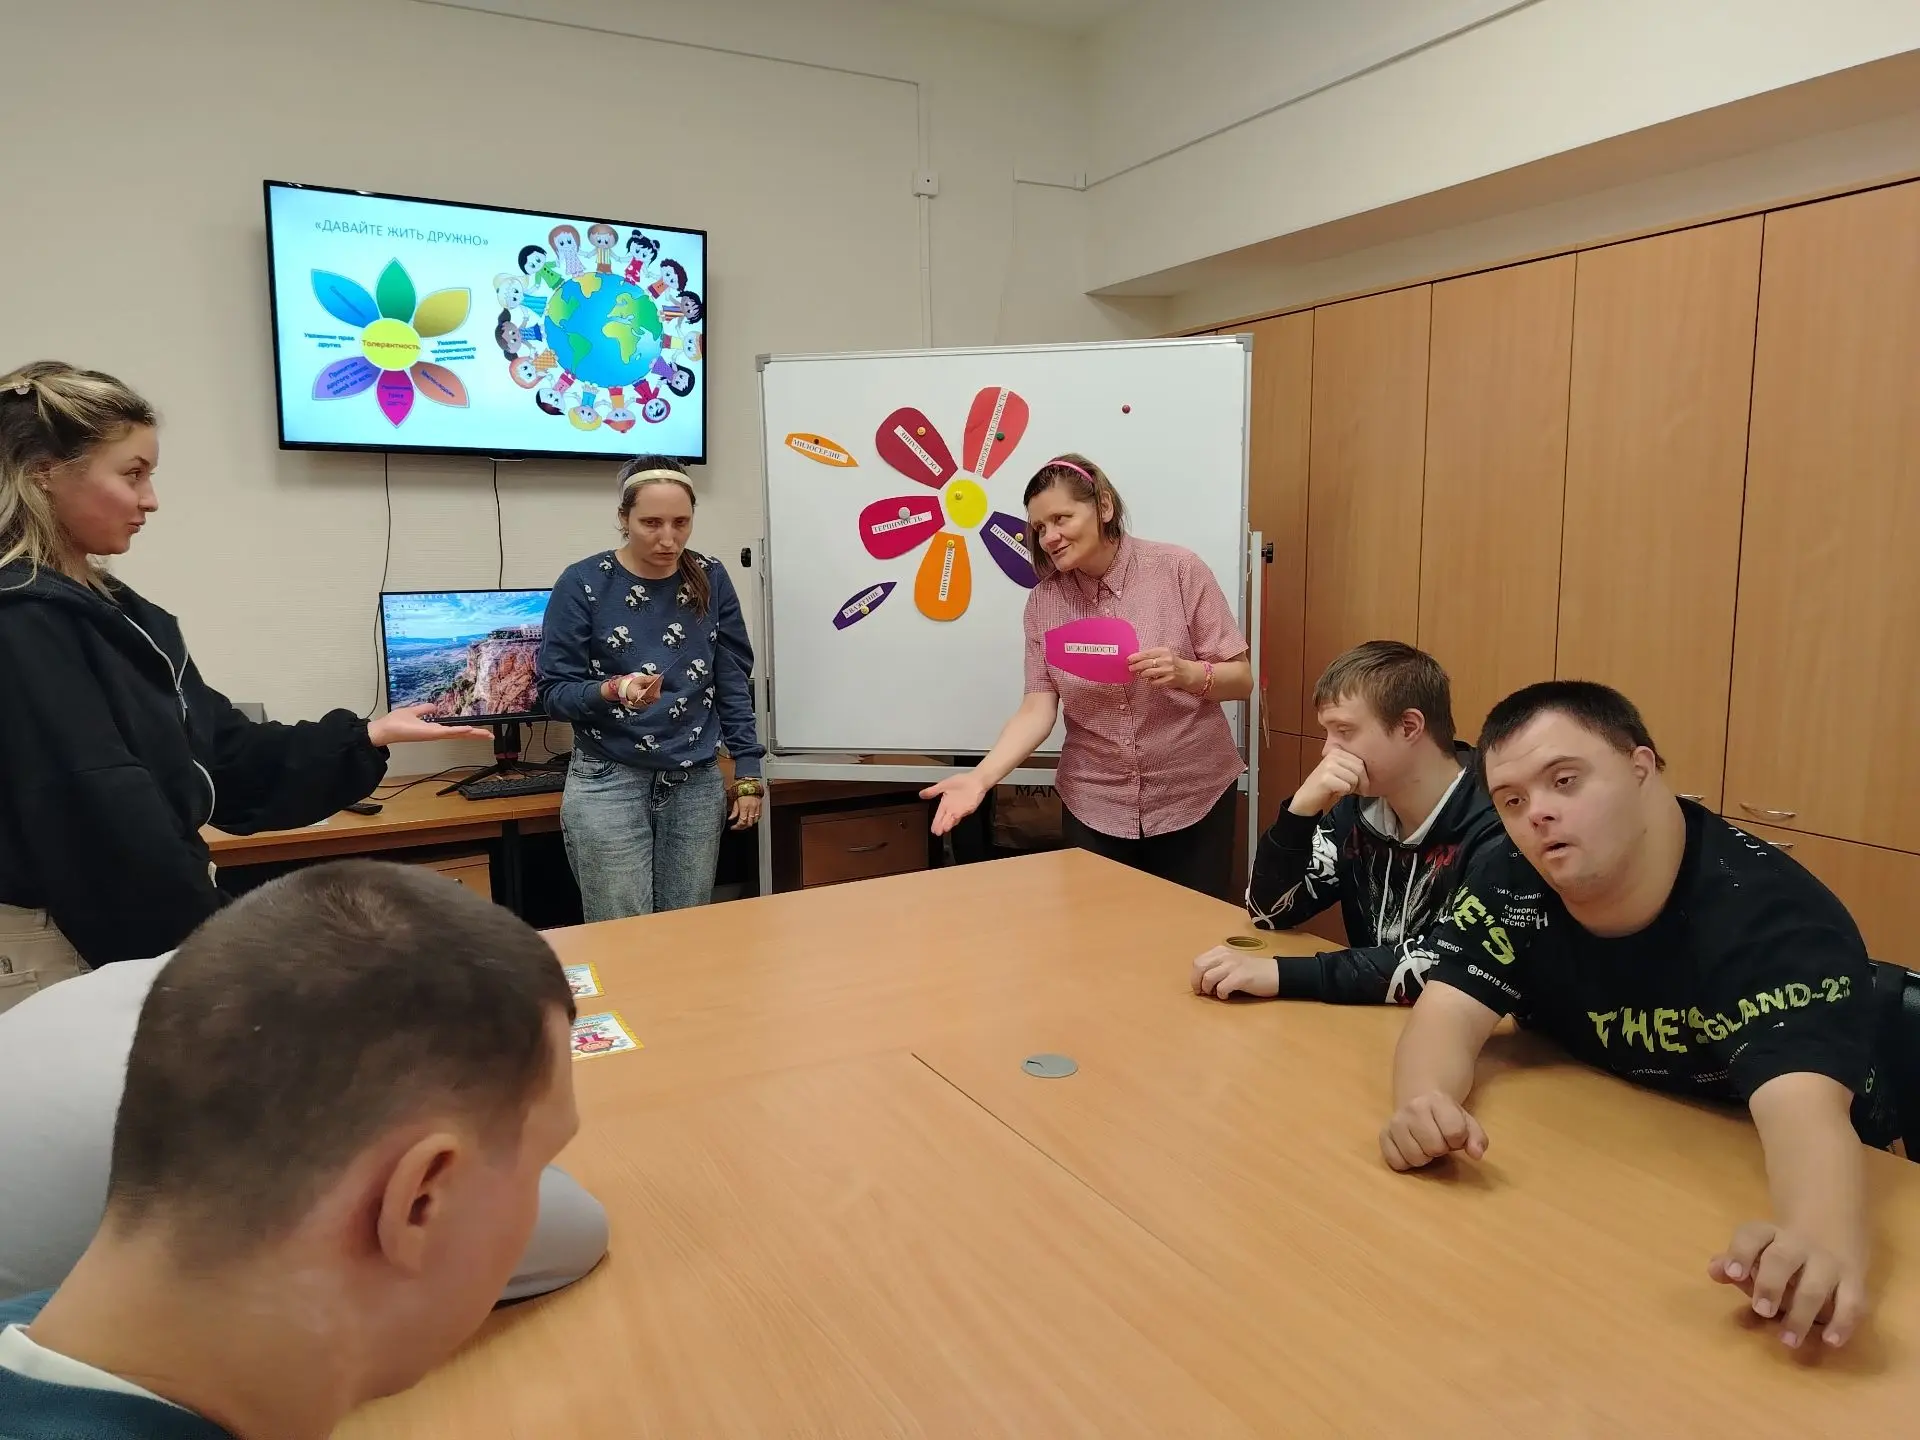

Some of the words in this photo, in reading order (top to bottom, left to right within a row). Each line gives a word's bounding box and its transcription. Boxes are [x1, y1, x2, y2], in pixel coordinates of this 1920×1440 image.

[314, 219, 383, 237] «ДАВАЙТЕ
[387, 225, 425, 241] ЖИТЬ
[427, 230, 489, 247] ДРУЖНО»
[975, 391, 1008, 475] ДОБРОЖЕЛАТЕЛЬНОСТЬ
[793, 439, 843, 460] МИЛОСЕРДИЕ
[900, 431, 941, 474] СОСТРАДАНИЕ
[874, 515, 923, 533] ТЕРПИМОСТЬ
[991, 525, 1027, 556] ПРОЩЕНИЕ
[844, 591, 879, 617] УВАЖЕНИЕ
[1065, 643, 1117, 654] ВЕЖЛИВОСТЬ
